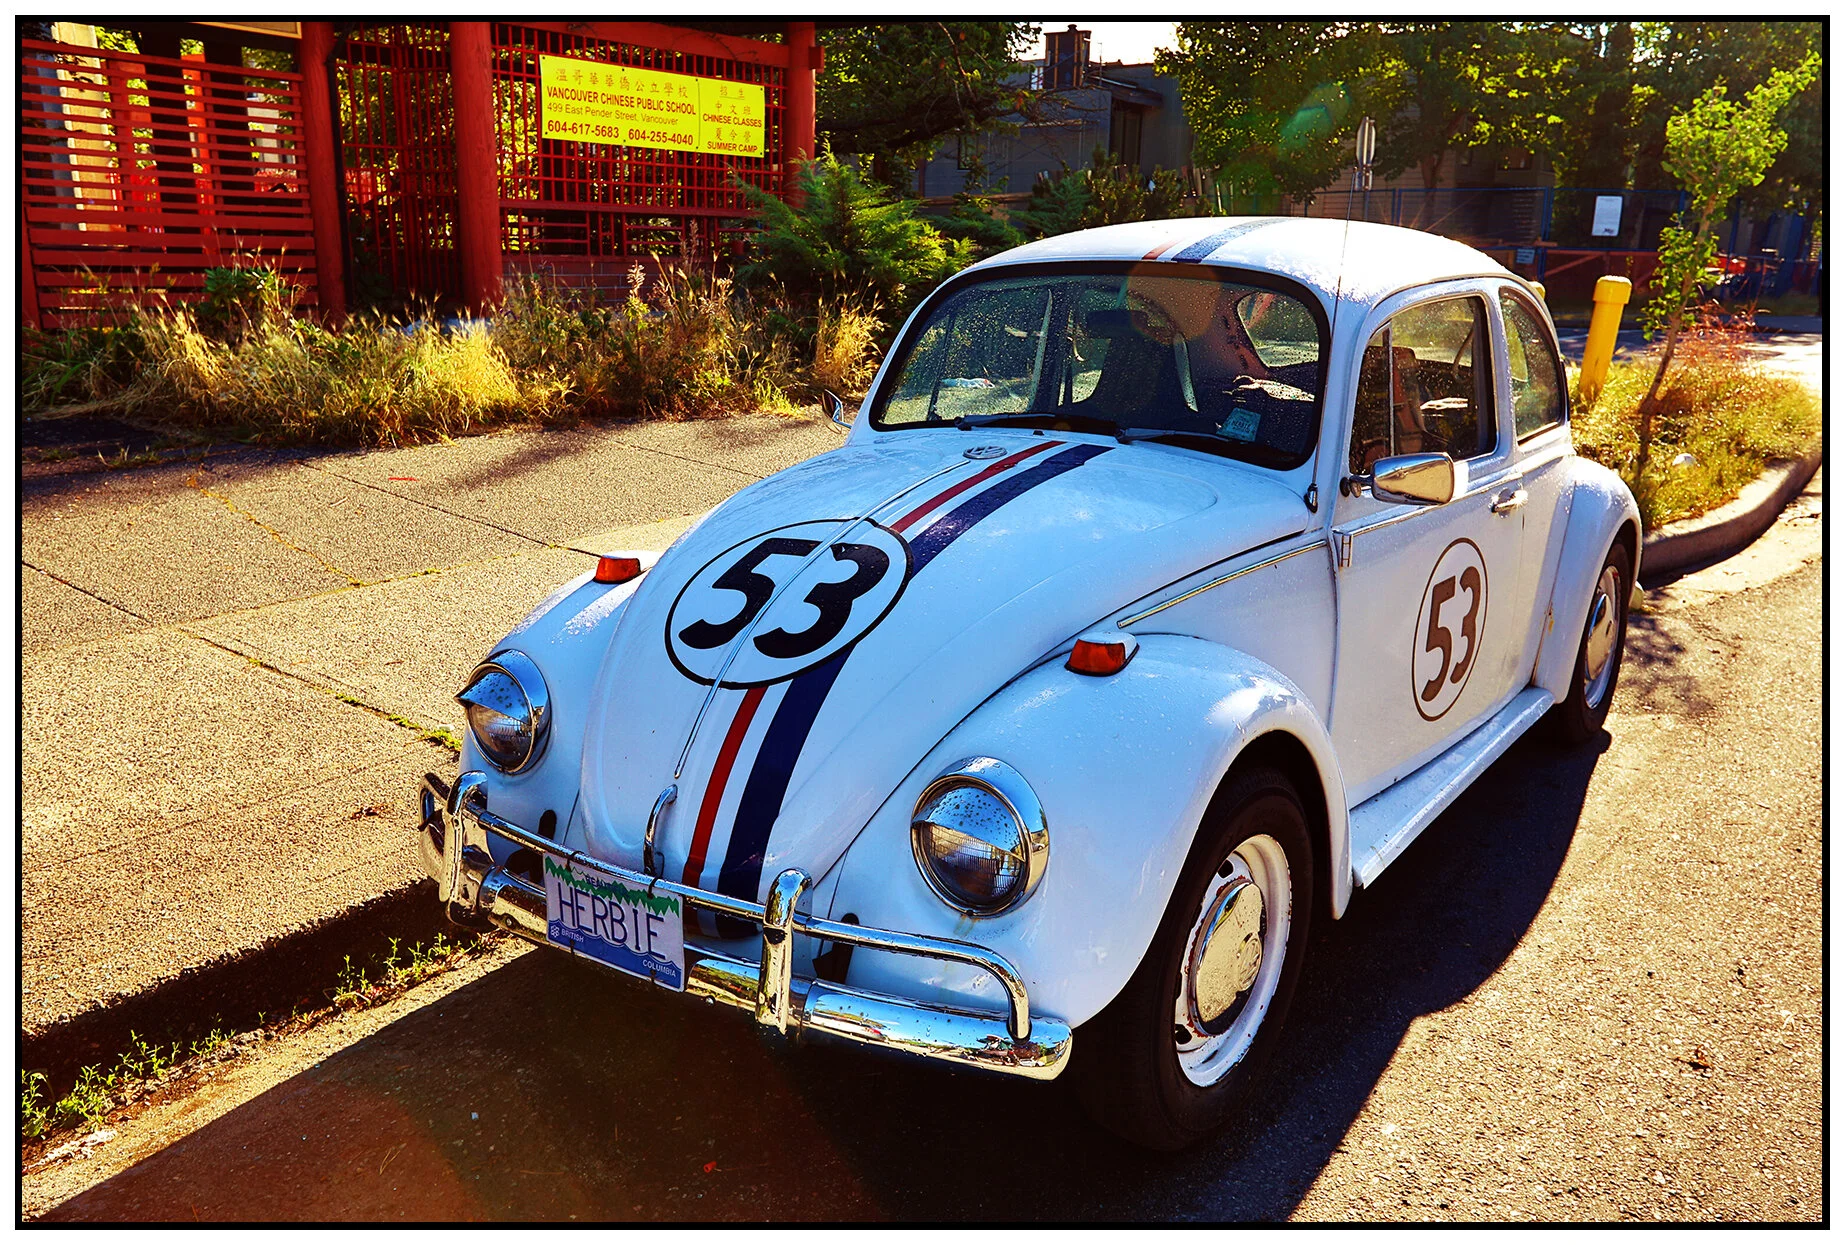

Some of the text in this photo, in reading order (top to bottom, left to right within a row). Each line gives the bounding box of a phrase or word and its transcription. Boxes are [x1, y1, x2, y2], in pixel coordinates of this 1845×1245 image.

[547, 86, 697, 116] VANCOUVER CHINESE PUBLIC SCHOOL
[547, 103, 563, 114] 499
[565, 104, 583, 116] East
[585, 107, 612, 120] Pender
[640, 113, 679, 126] Vancouver
[702, 113, 763, 128] CHINESE CLASSES
[547, 120, 694, 146] 604-617-5683 604-255-4040
[707, 141, 758, 153] SUMMER CAMP
[678, 537, 890, 659] 53
[1421, 566, 1481, 702] 53
[558, 881, 666, 960] HERBIE
[561, 928, 584, 943] BRITISH
[642, 959, 677, 978] COLUMBIA
